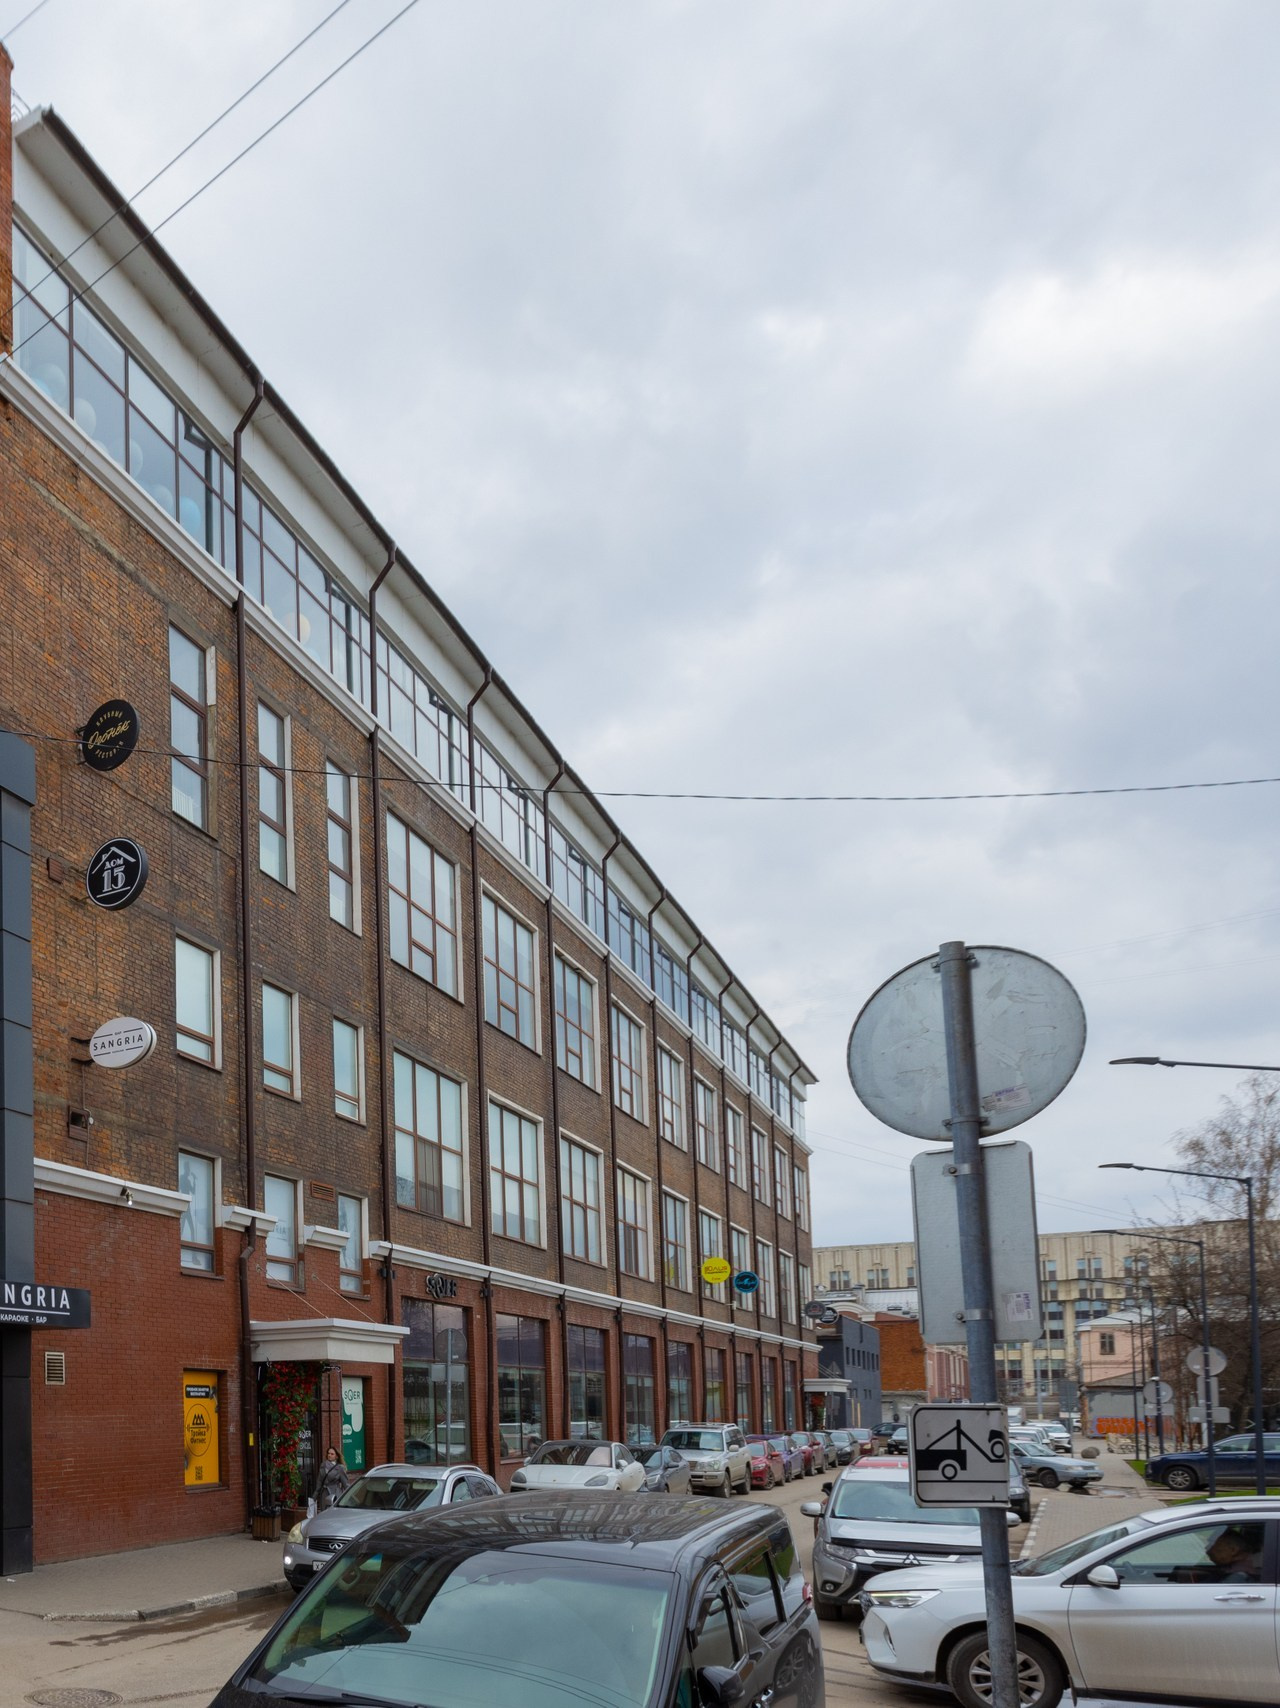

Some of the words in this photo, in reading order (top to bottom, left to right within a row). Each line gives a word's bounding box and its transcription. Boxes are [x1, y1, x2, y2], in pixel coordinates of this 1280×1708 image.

[104, 857, 124, 870] ДОМ
[102, 865, 126, 893] 15
[93, 1034, 143, 1051] SANGRIA
[0, 1313, 30, 1323] КАРАОКЕ
[35, 1315, 47, 1324] БАР
